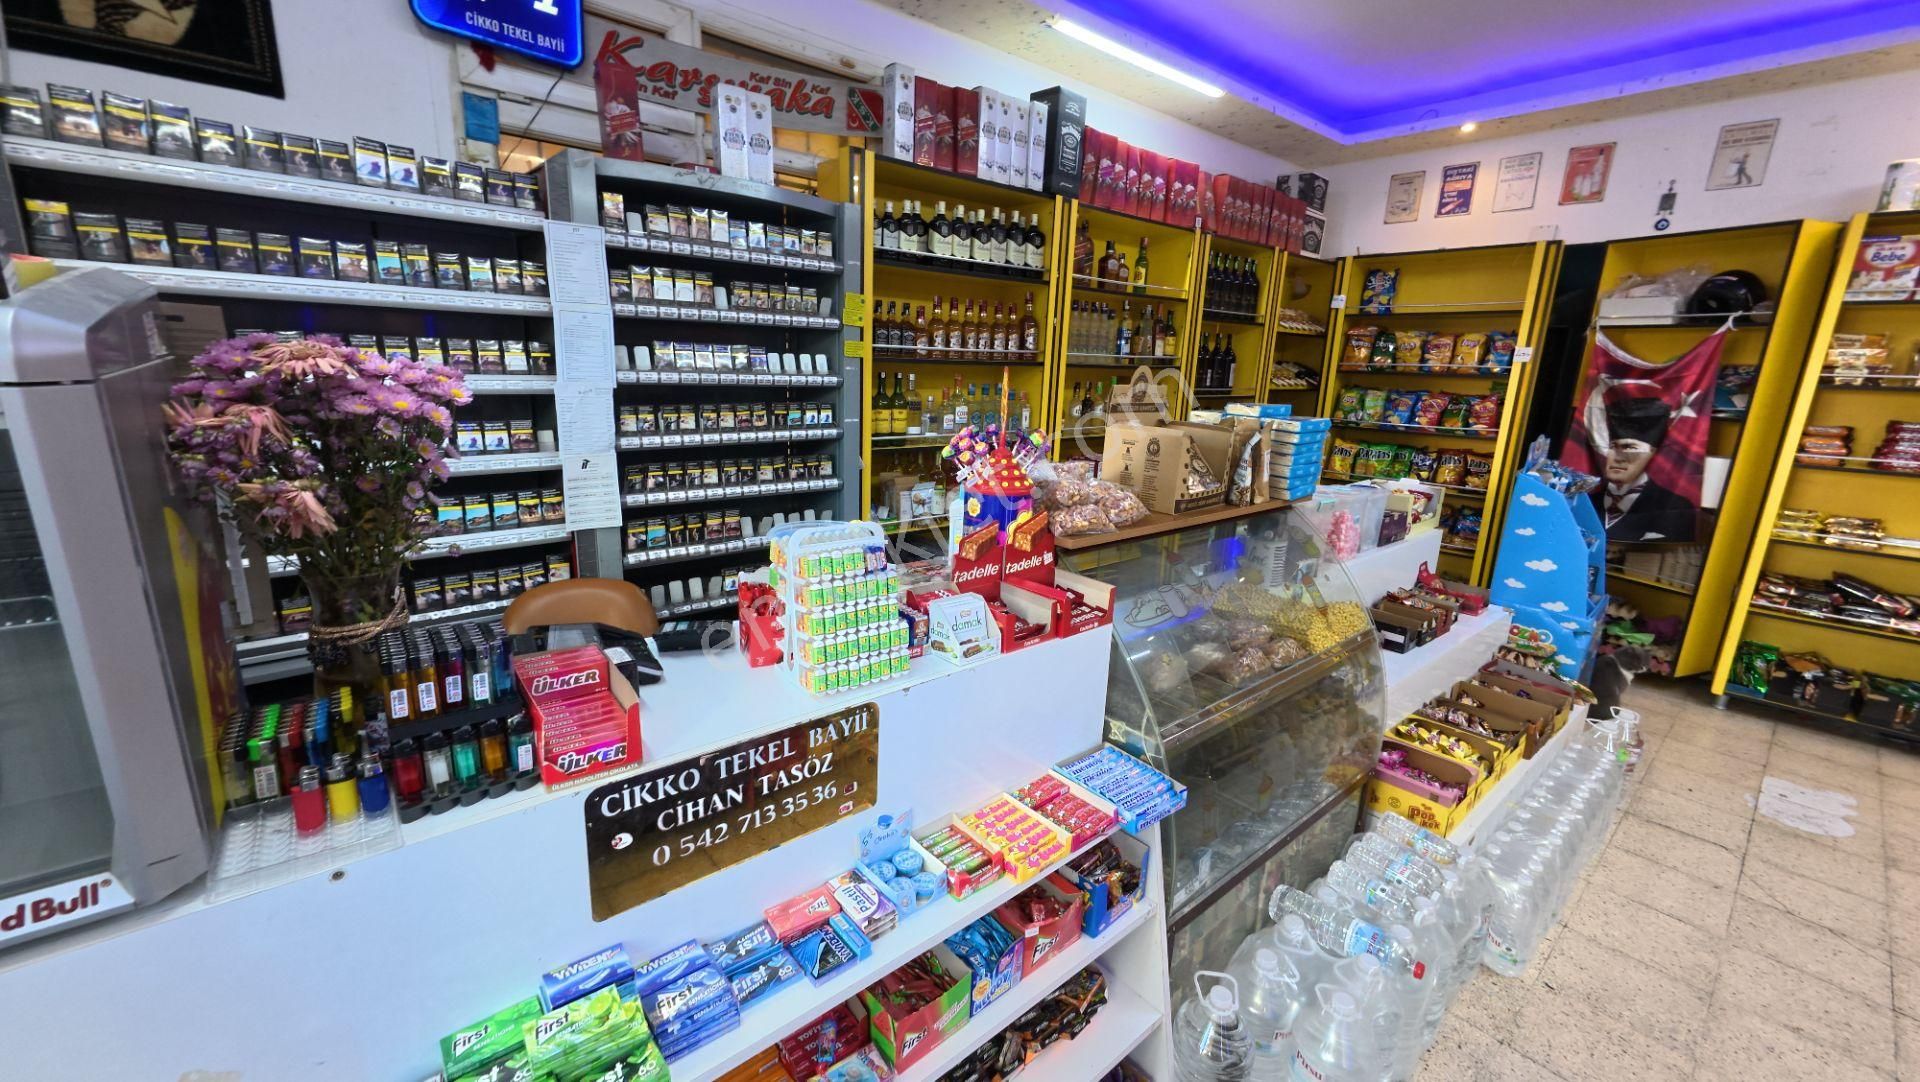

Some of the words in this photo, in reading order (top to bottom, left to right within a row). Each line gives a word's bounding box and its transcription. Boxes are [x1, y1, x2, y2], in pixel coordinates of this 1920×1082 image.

[465, 11, 499, 32] CİKKO
[502, 23, 535, 44] TEKEL
[537, 34, 565, 53] BAYİİ
[651, 88, 678, 101] Kaf
[749, 72, 769, 85] Kaf
[772, 76, 791, 90] Sin
[811, 83, 831, 96] Kaf
[1871, 252, 1906, 262] Bebe
[953, 563, 998, 584] tadelle
[1005, 555, 1042, 575] tadelle
[951, 611, 982, 632] damak
[532, 670, 600, 696] ÜLKER
[558, 744, 627, 775] ÜLKER
[601, 767, 701, 818] CİKKO
[714, 737, 797, 780] TEKEL
[808, 710, 868, 749] BAYİİ
[1071, 758, 1103, 776] mentos
[656, 783, 745, 832] CİHAN
[758, 752, 834, 796] TASÖZ
[1121, 790, 1154, 810] mentos
[1139, 809, 1171, 830] mentos
[652, 845, 671, 866] 0
[679, 822, 729, 858] 542
[737, 803, 777, 834] 713
[31, 882, 100, 924] Bull
[806, 895, 830, 915] First
[737, 928, 772, 956] First
[1033, 930, 1061, 959] First
[731, 963, 769, 994] First
[778, 965, 793, 978] 60
[656, 985, 694, 1015] First
[452, 1024, 490, 1054] First
[534, 1011, 570, 1040] First
[902, 1026, 928, 1053] First
